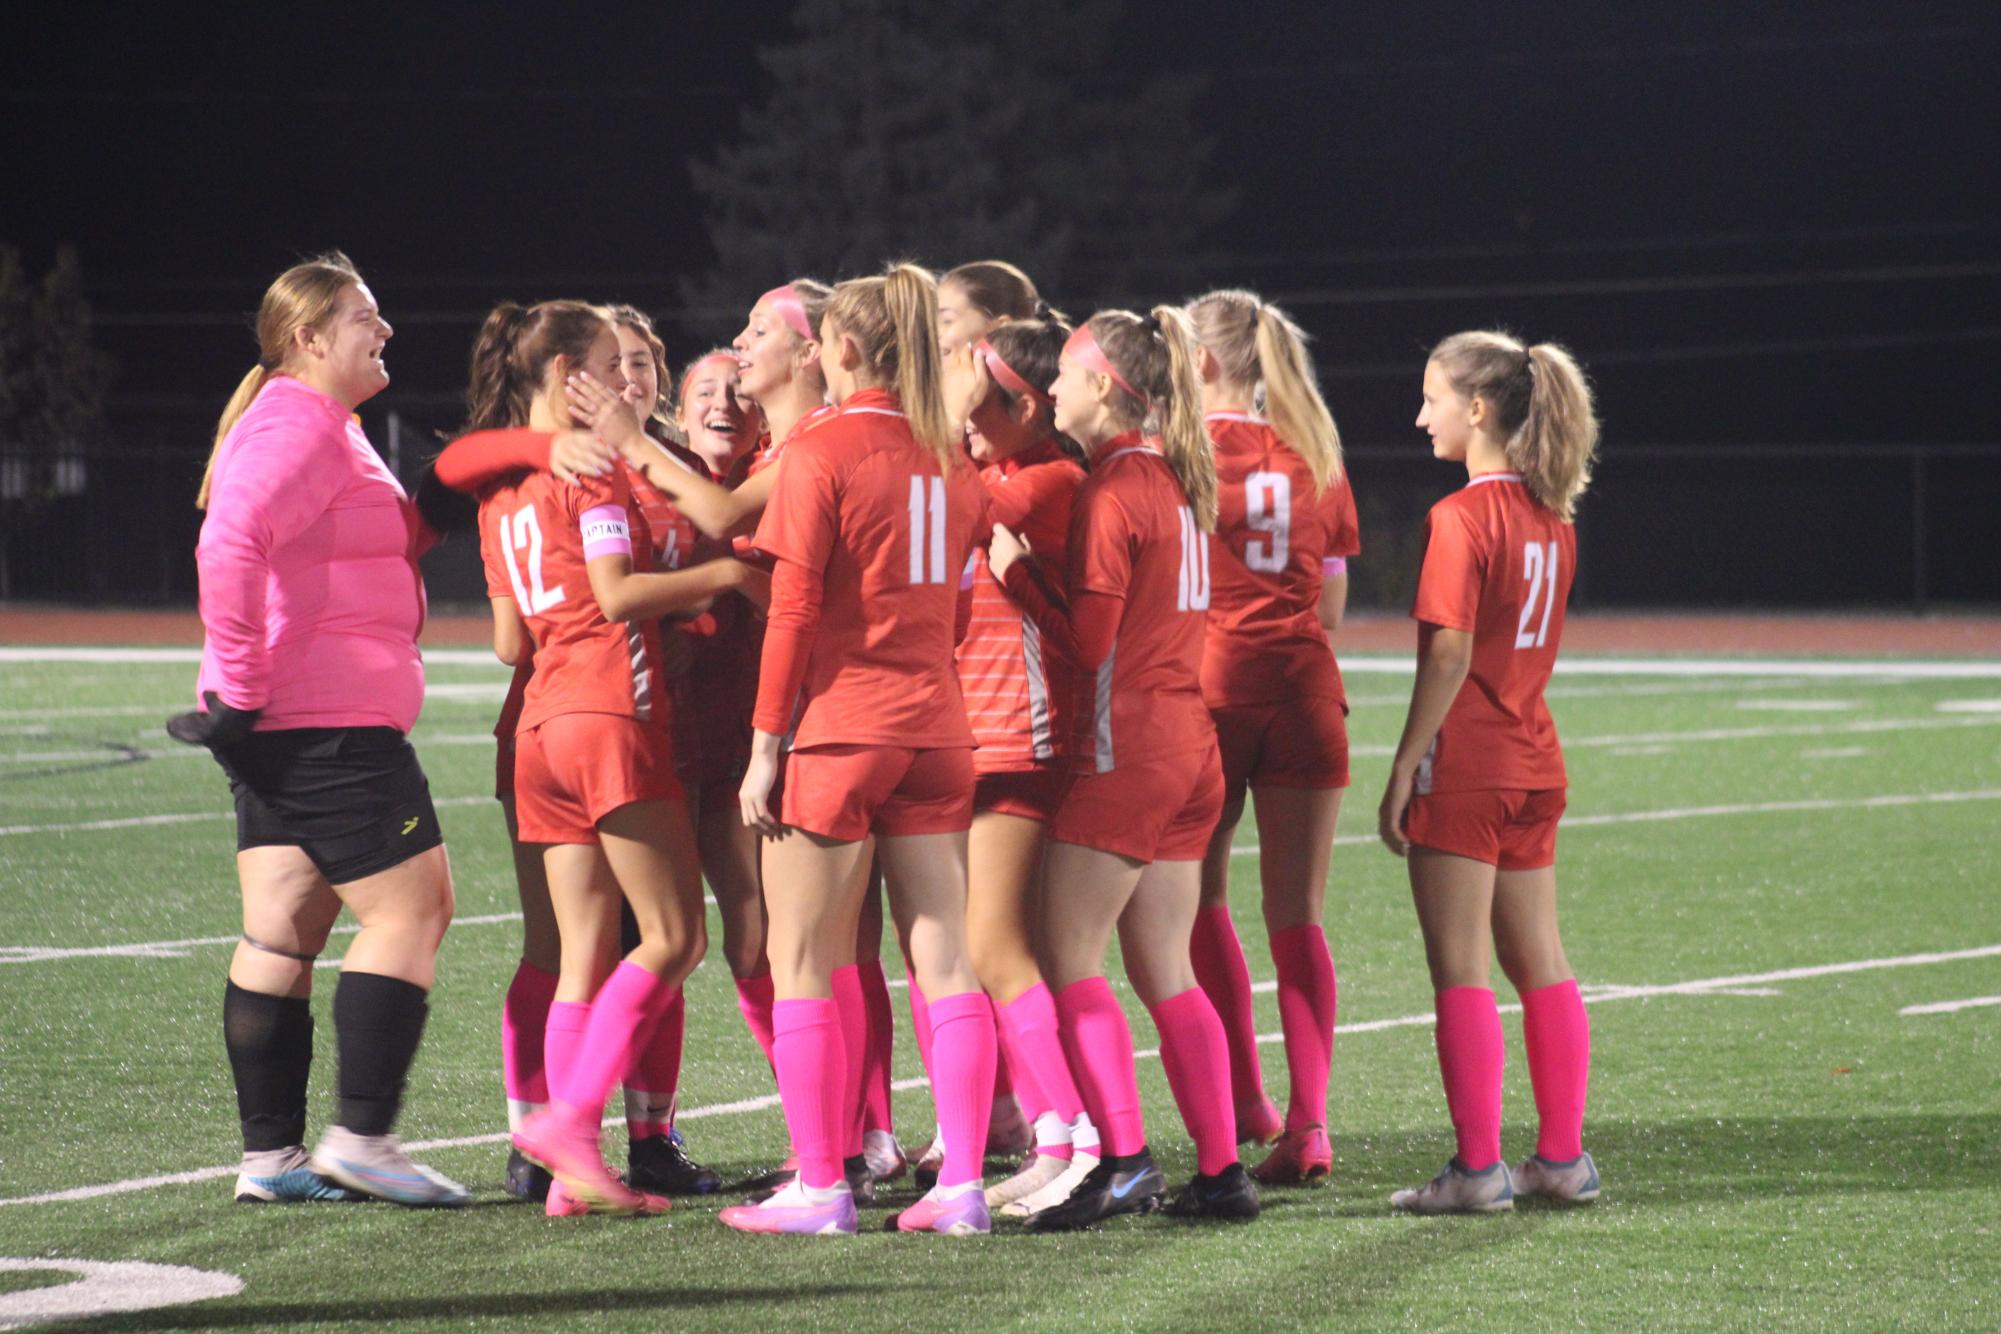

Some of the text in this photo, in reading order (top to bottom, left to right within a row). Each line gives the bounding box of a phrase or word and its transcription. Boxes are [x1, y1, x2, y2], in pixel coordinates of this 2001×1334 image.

[500, 503, 567, 617] 12
[583, 523, 623, 538] APTAIN
[907, 475, 947, 584] 11
[1177, 505, 1211, 612] 10
[1245, 471, 1291, 573] 9
[1514, 541, 1558, 650] 21
